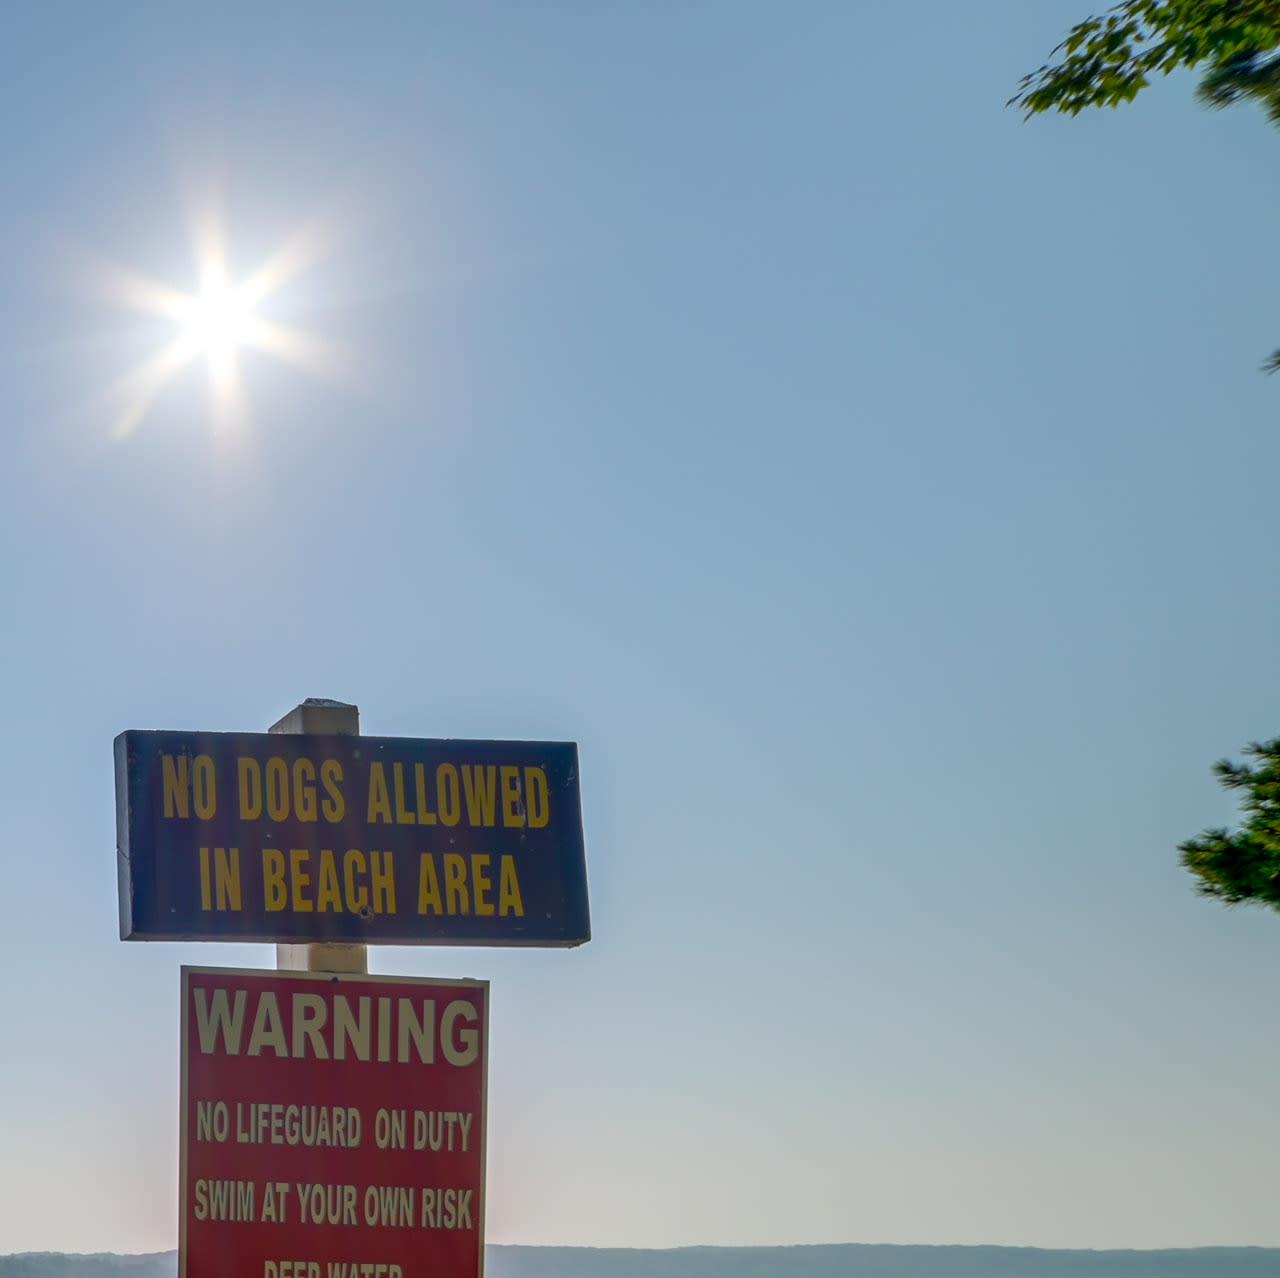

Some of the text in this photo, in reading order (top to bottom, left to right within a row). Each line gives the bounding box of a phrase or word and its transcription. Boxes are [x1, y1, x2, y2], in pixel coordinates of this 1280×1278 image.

[161, 754, 551, 829] NO DOGS ALLOWED
[199, 847, 525, 917] IN BEACH AREA
[193, 986, 480, 1067] WARNING
[196, 1100, 473, 1152] NO LIFEGUARD ON DUTY
[194, 1179, 473, 1230] SWIM AT YOUR OWN RISK
